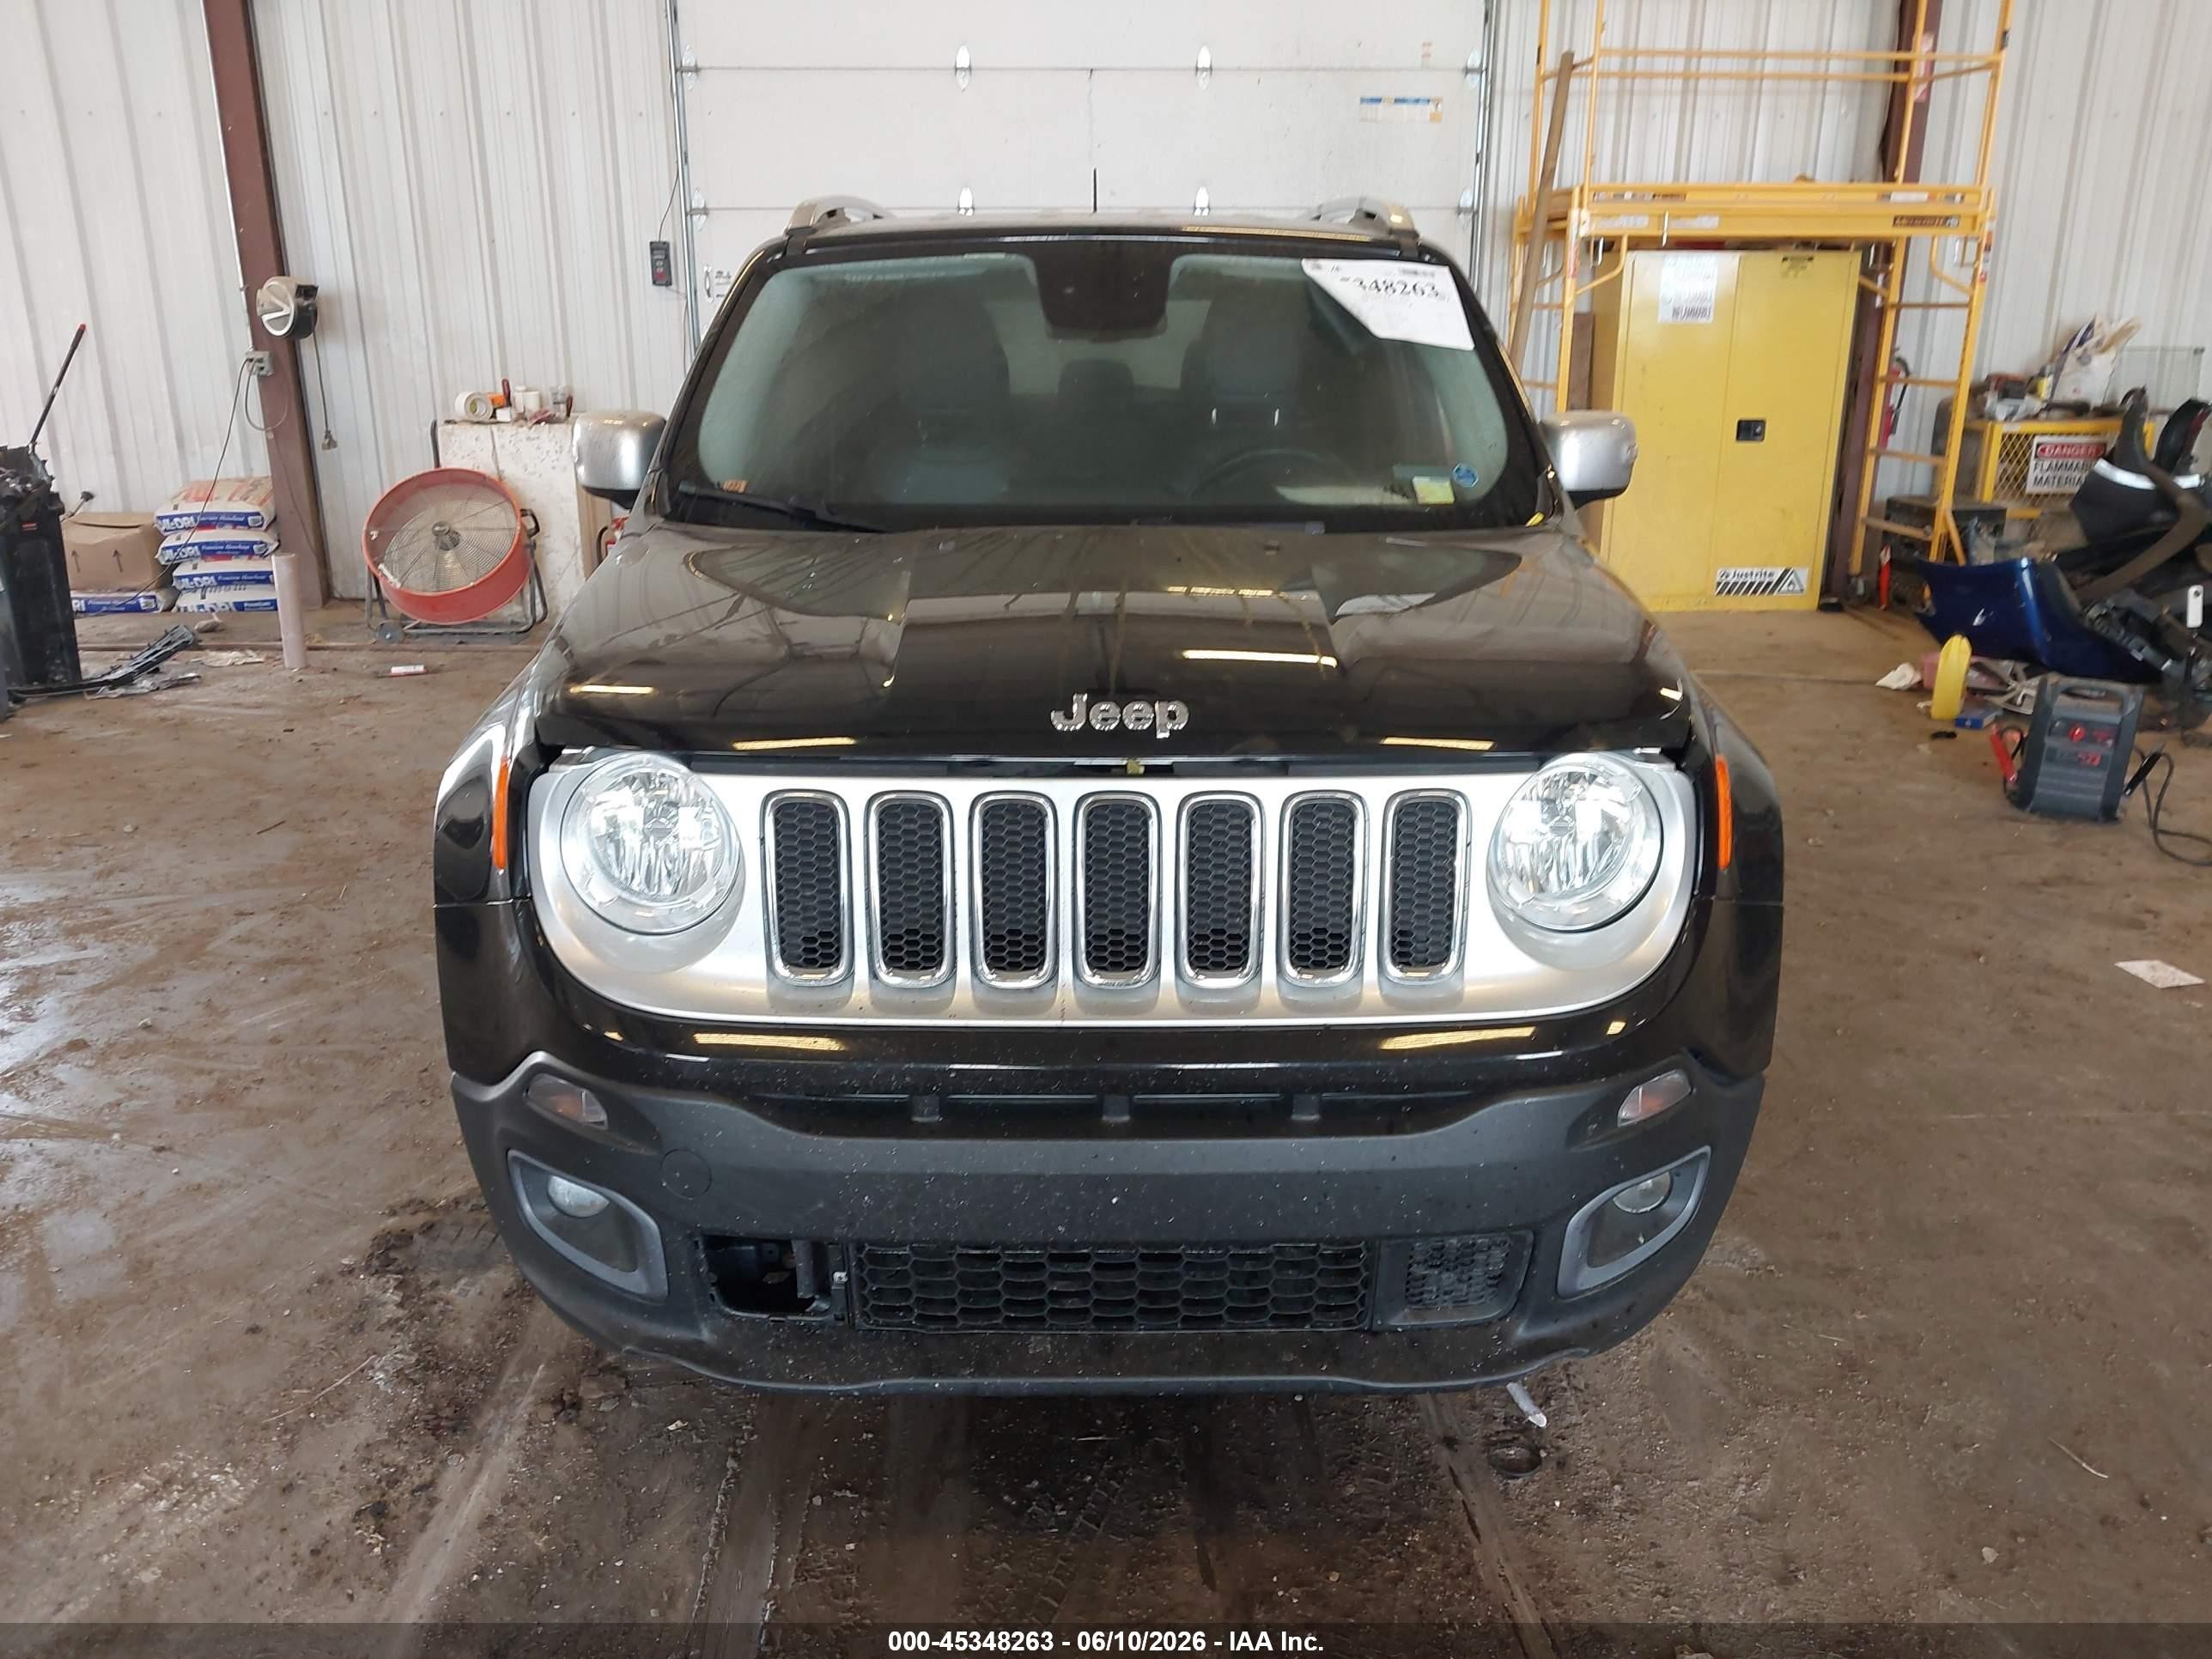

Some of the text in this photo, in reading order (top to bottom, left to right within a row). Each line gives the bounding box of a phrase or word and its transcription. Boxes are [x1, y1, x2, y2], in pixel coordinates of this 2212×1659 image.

[2045, 446, 2098, 456] DANGER
[2033, 461, 2091, 473] FLAMMAB
[2033, 475, 2084, 488] MATERIA
[1050, 693, 1190, 739] Jeep
